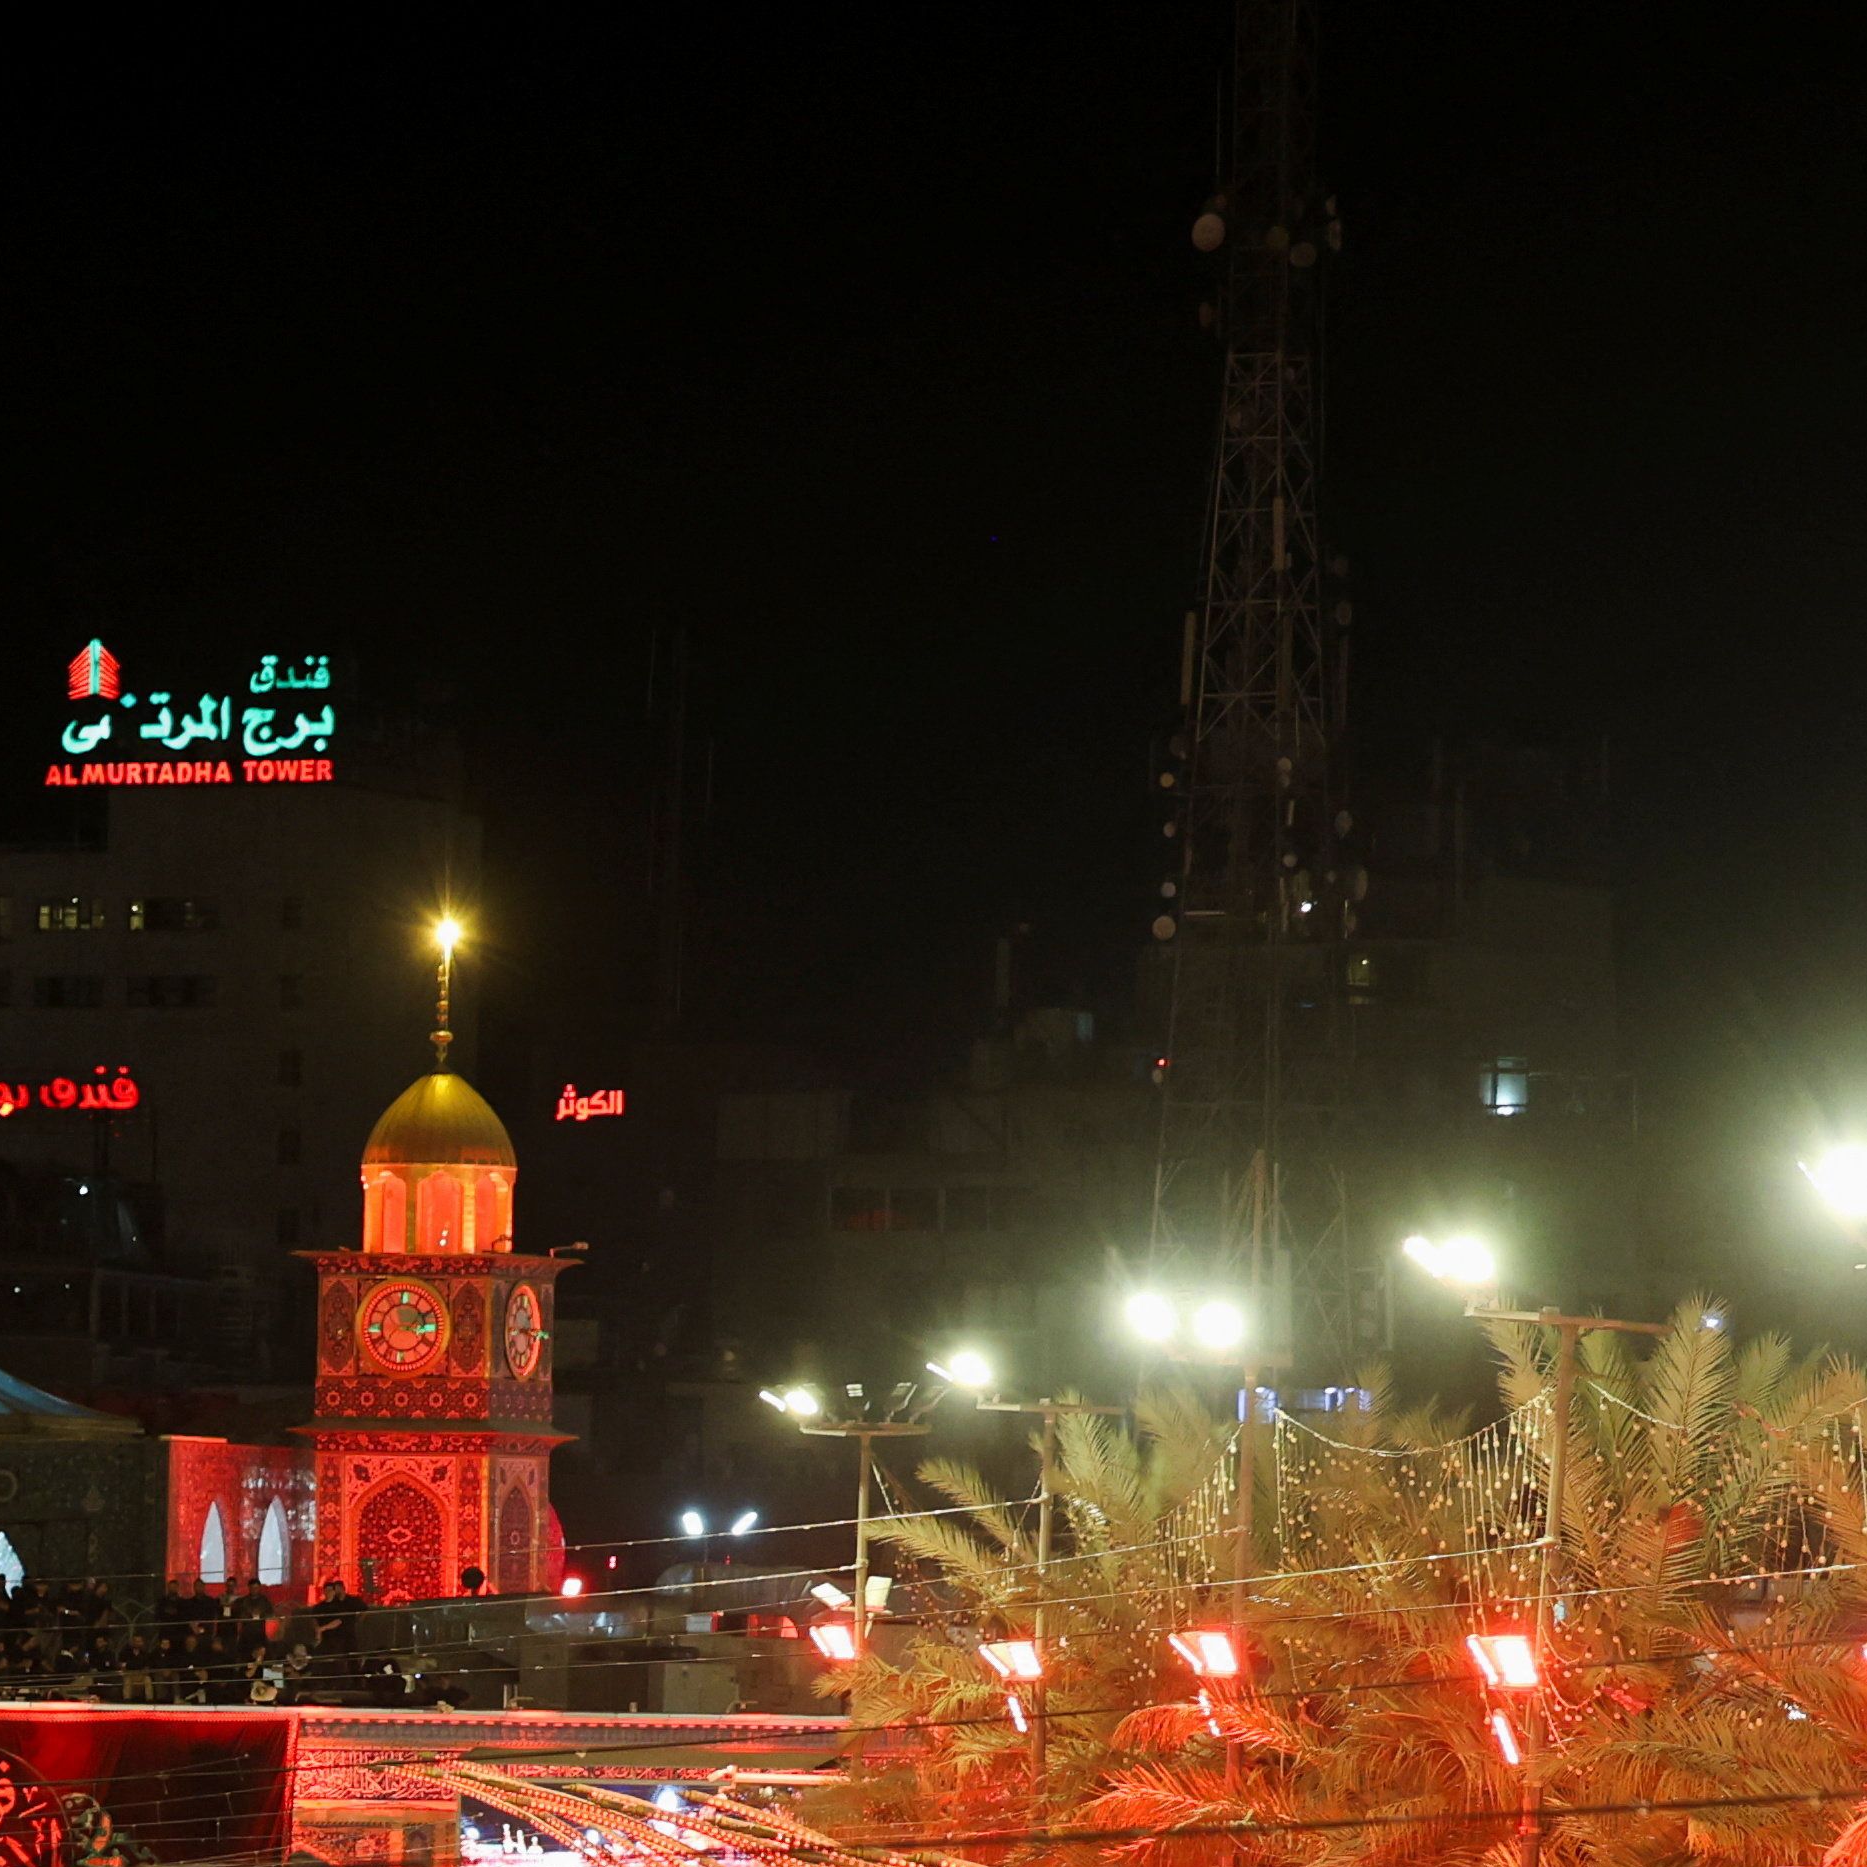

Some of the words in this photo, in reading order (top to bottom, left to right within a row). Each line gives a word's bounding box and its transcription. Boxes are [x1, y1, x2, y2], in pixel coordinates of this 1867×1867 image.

[250, 655, 331, 693] فندق
[242, 705, 335, 756] برج
[243, 759, 335, 782] TOWER
[555, 1083, 625, 1121] الكوثر
